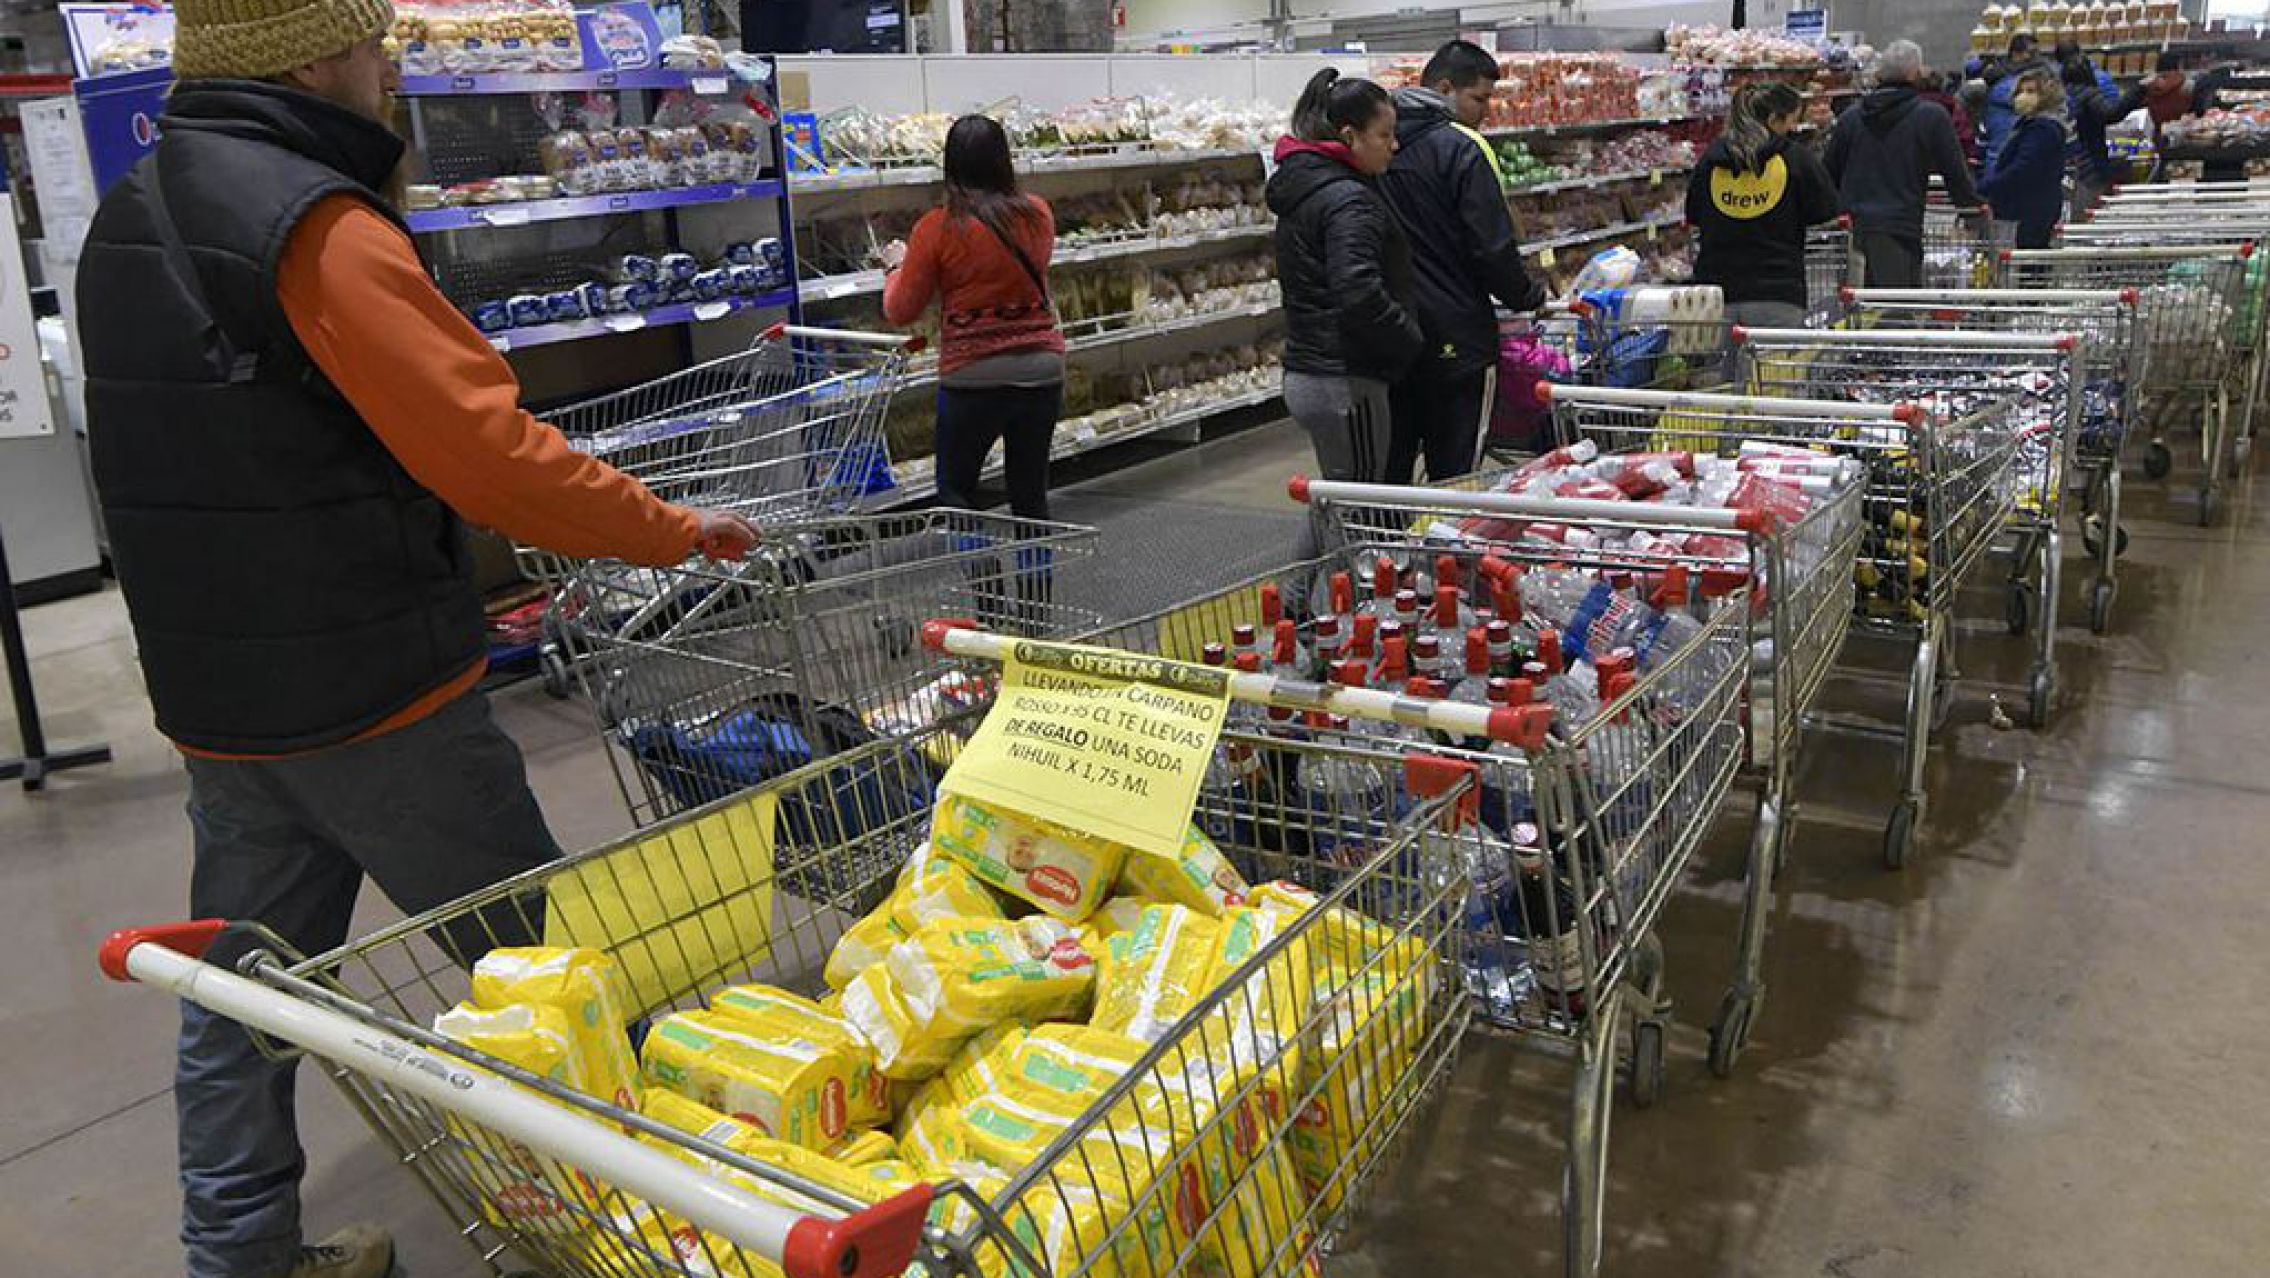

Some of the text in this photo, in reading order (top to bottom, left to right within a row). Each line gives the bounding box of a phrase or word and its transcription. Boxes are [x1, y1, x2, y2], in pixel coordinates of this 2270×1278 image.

[1721, 190, 1770, 209] drew
[1070, 653, 1163, 680] OFERTAS
[1022, 670, 1104, 699] LLEVANDO
[1127, 686, 1214, 722] CARPANO
[1004, 717, 1182, 774] DE REGALO UNA SODA
[1093, 706, 1111, 725] CL
[1117, 711, 1138, 732] TE
[1140, 717, 1206, 750] LLEVAS
[1007, 741, 1149, 797] NIHUIL X 1,75 ML
